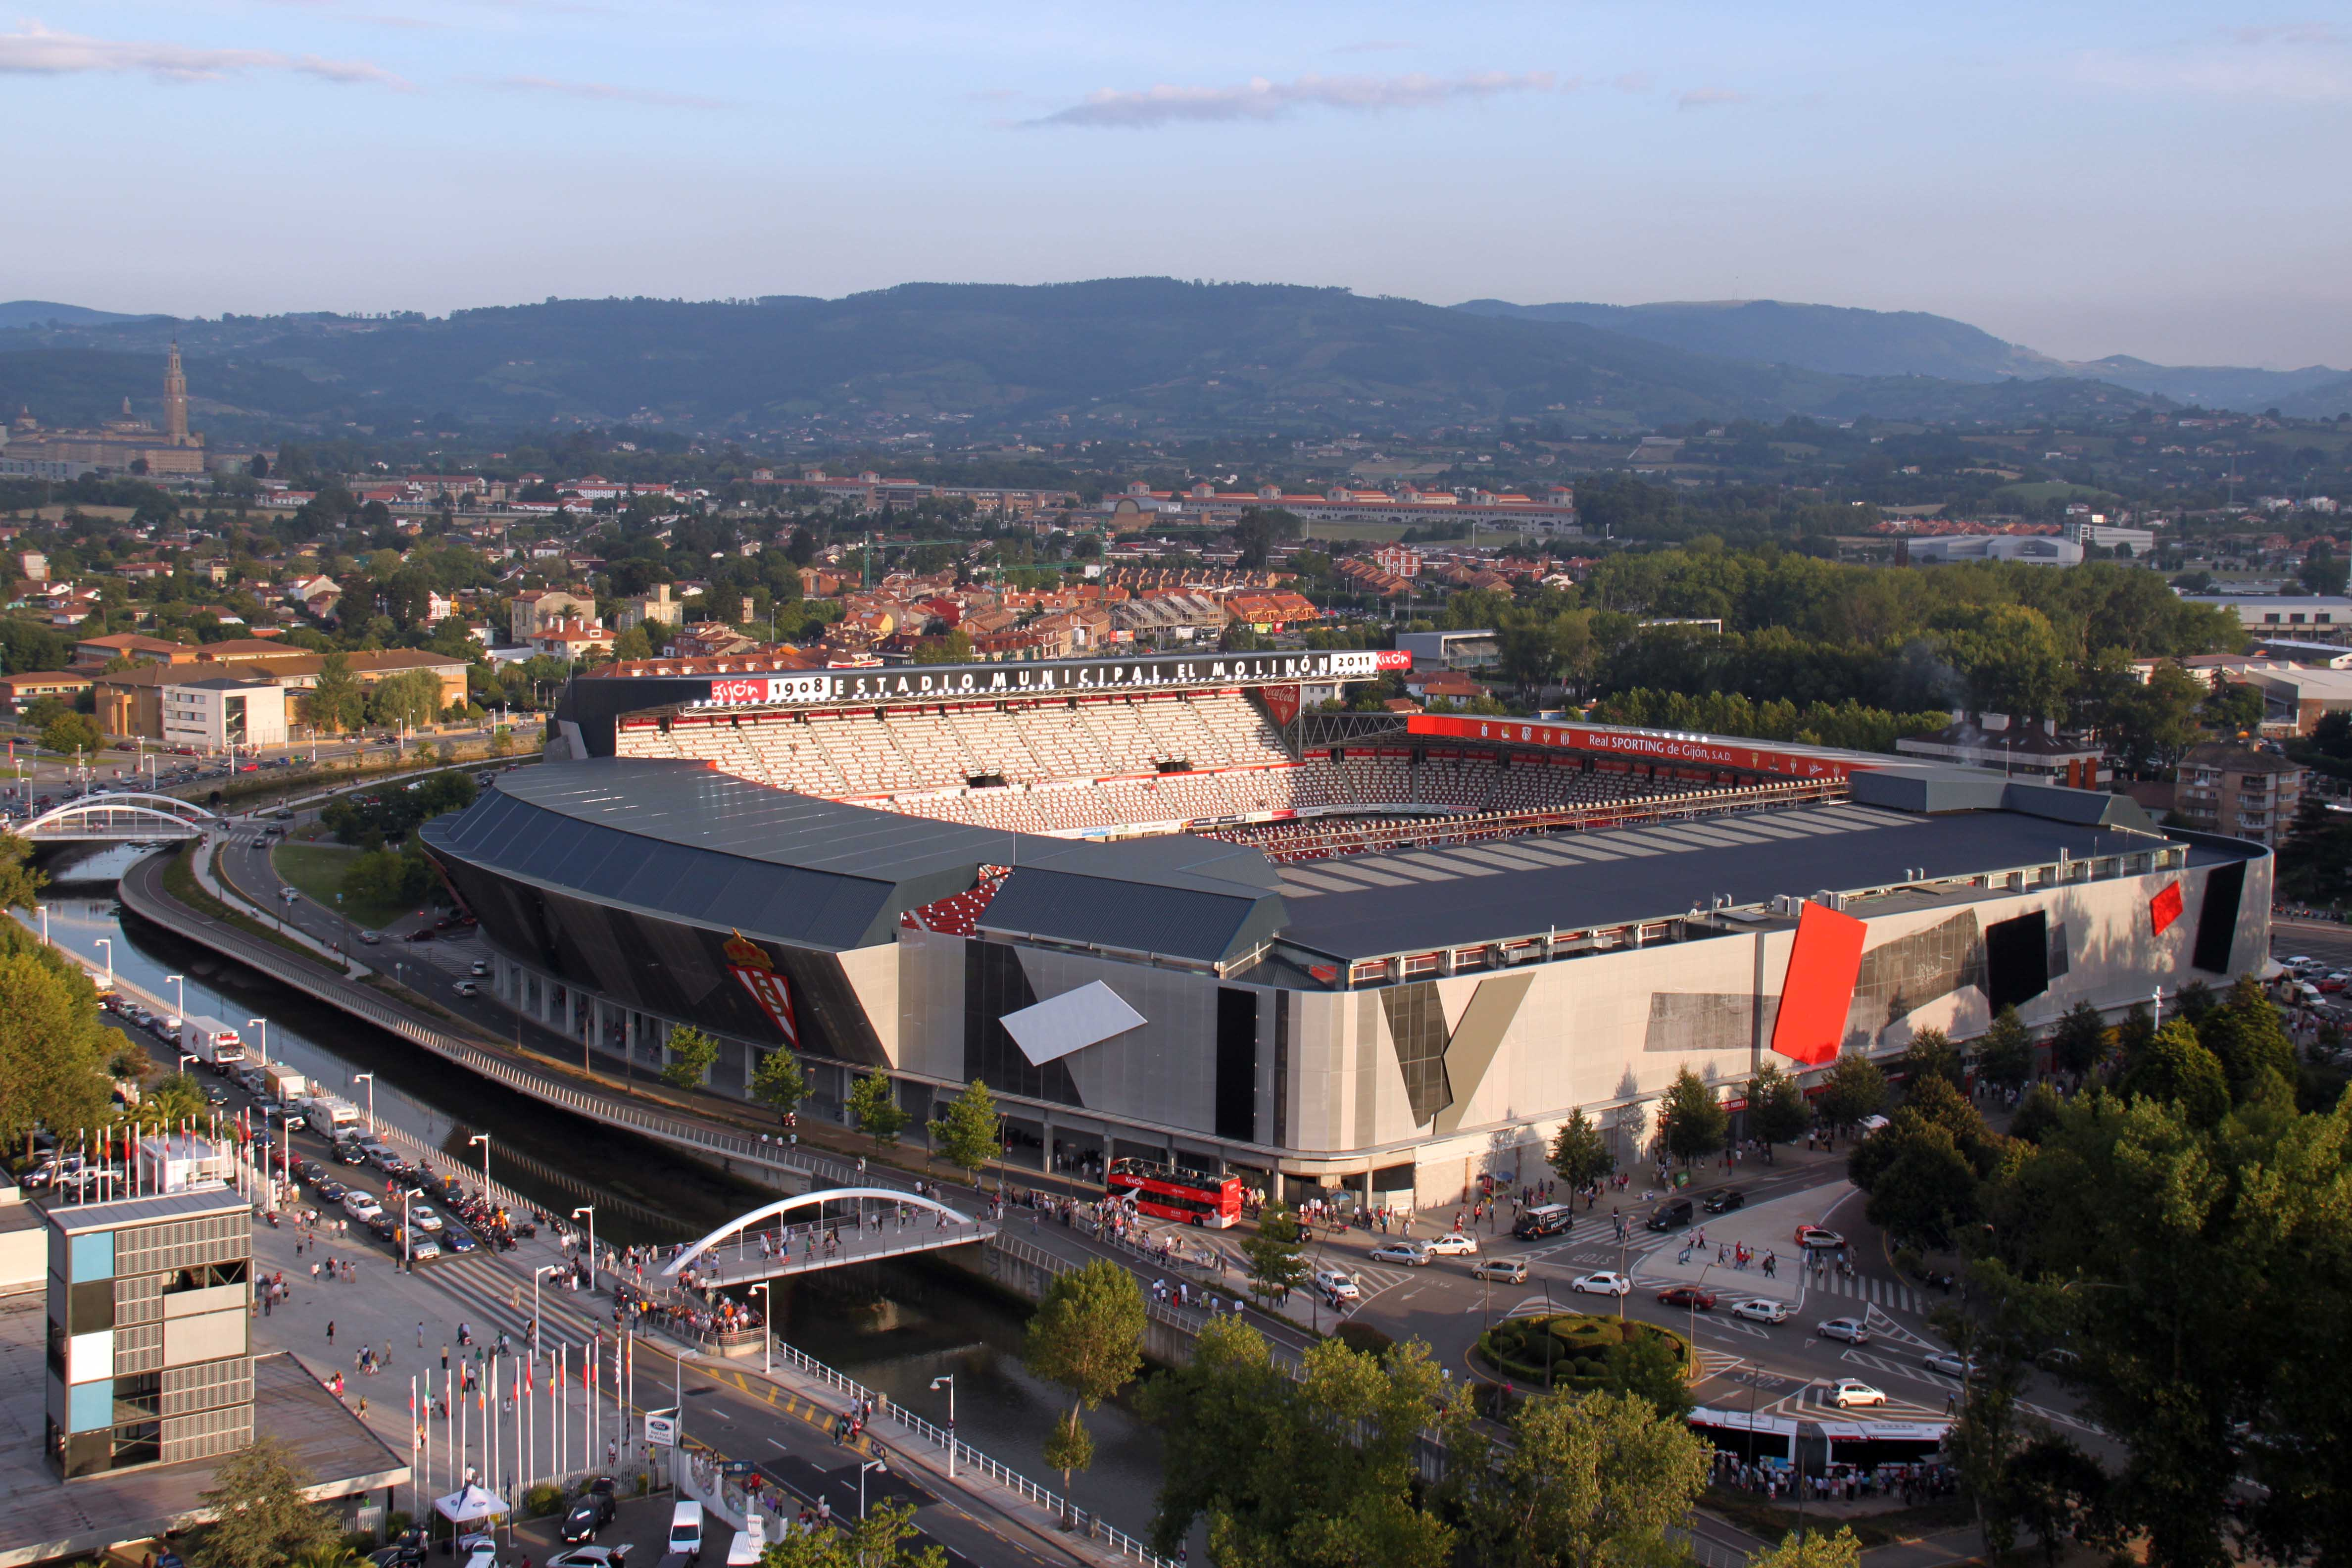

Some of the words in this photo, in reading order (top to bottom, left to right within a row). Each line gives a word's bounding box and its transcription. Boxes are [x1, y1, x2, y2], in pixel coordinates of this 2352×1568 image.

[1338, 657, 1369, 667] 2011
[835, 674, 973, 695] ESTADIO
[992, 666, 1159, 686] MUNICIPAL
[1178, 663, 1195, 678] EL
[1212, 655, 1327, 677] MOLINÓN
[775, 678, 822, 697] 1908
[1589, 735, 1608, 746] Real
[1612, 737, 1664, 753] SPORTING
[1667, 744, 1679, 755] de
[1682, 744, 1710, 760] Gijón,
[1712, 752, 1732, 761] S.A.D.
[1734, 1372, 1785, 1388] STOP
